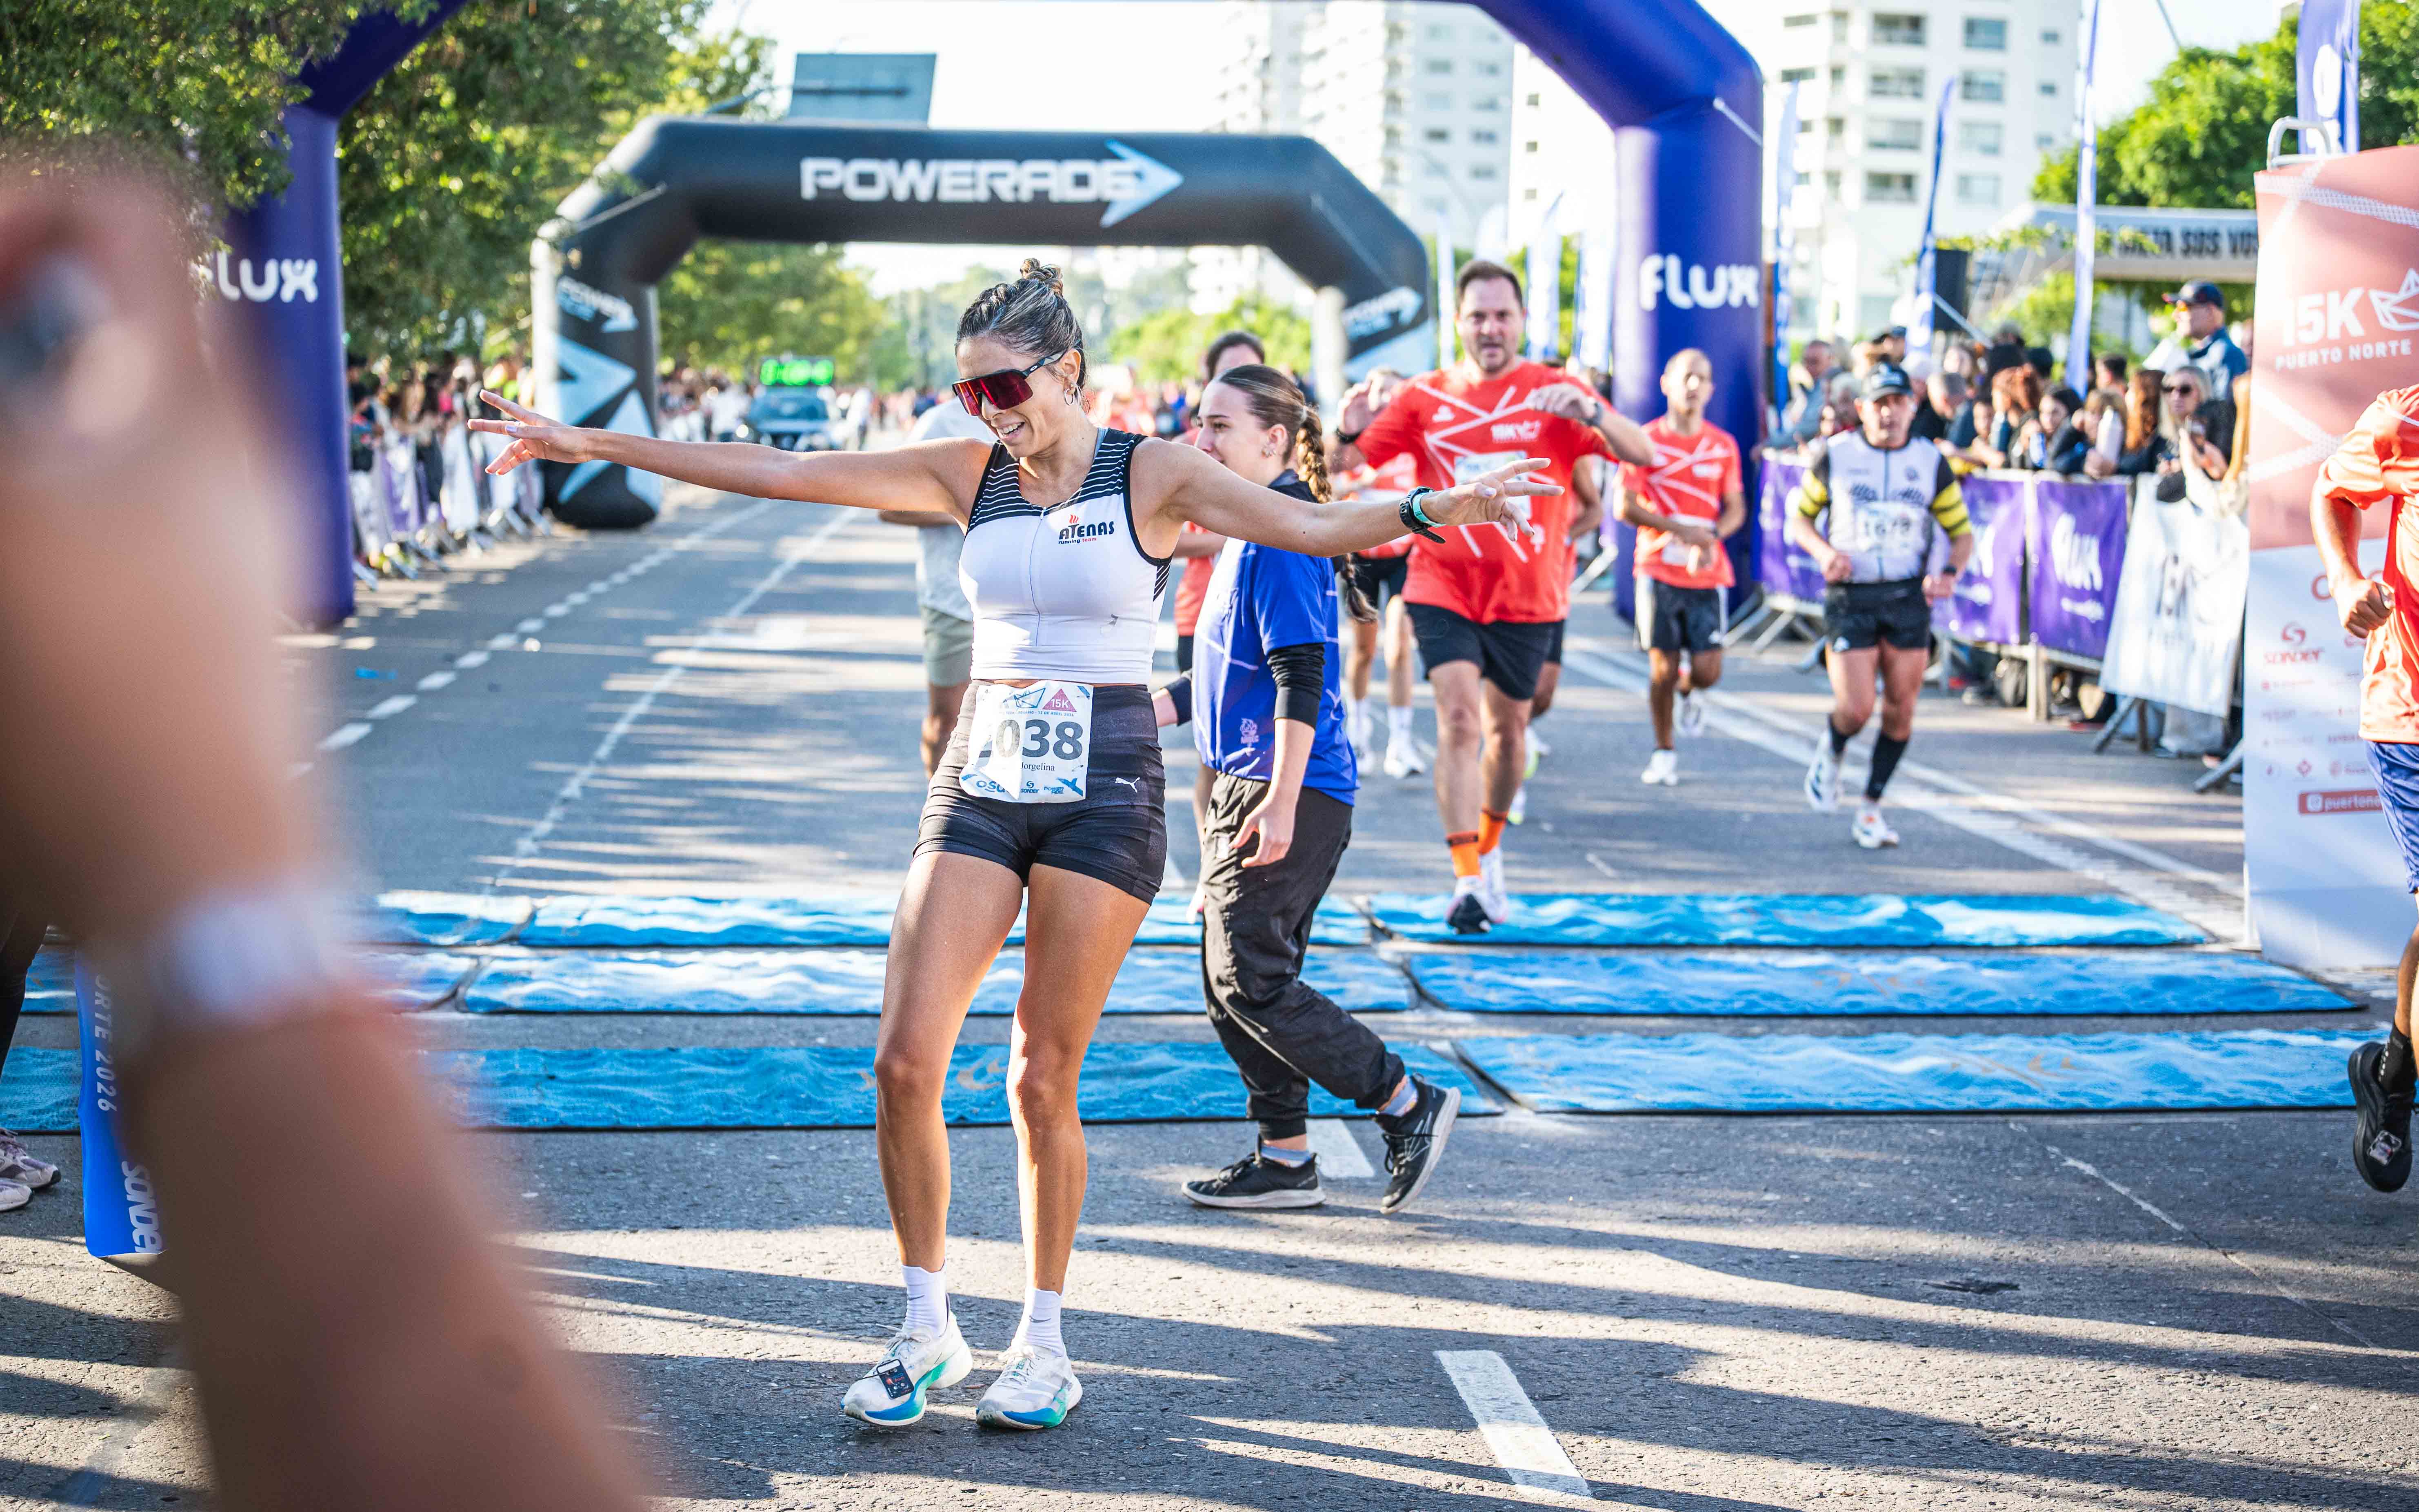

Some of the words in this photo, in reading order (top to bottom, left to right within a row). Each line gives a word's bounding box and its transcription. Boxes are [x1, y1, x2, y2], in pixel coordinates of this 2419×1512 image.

[204, 249, 319, 303] lux
[2281, 287, 2365, 347] 15K
[2275, 346, 2342, 372] PUERTO
[2348, 338, 2412, 362] NORTE
[1059, 521, 1115, 540] ATENAS
[1051, 698, 1069, 708] 15K
[979, 719, 1083, 760] 038
[1021, 762, 1055, 771] Jorgelina
[96, 1049, 117, 1111] 2026
